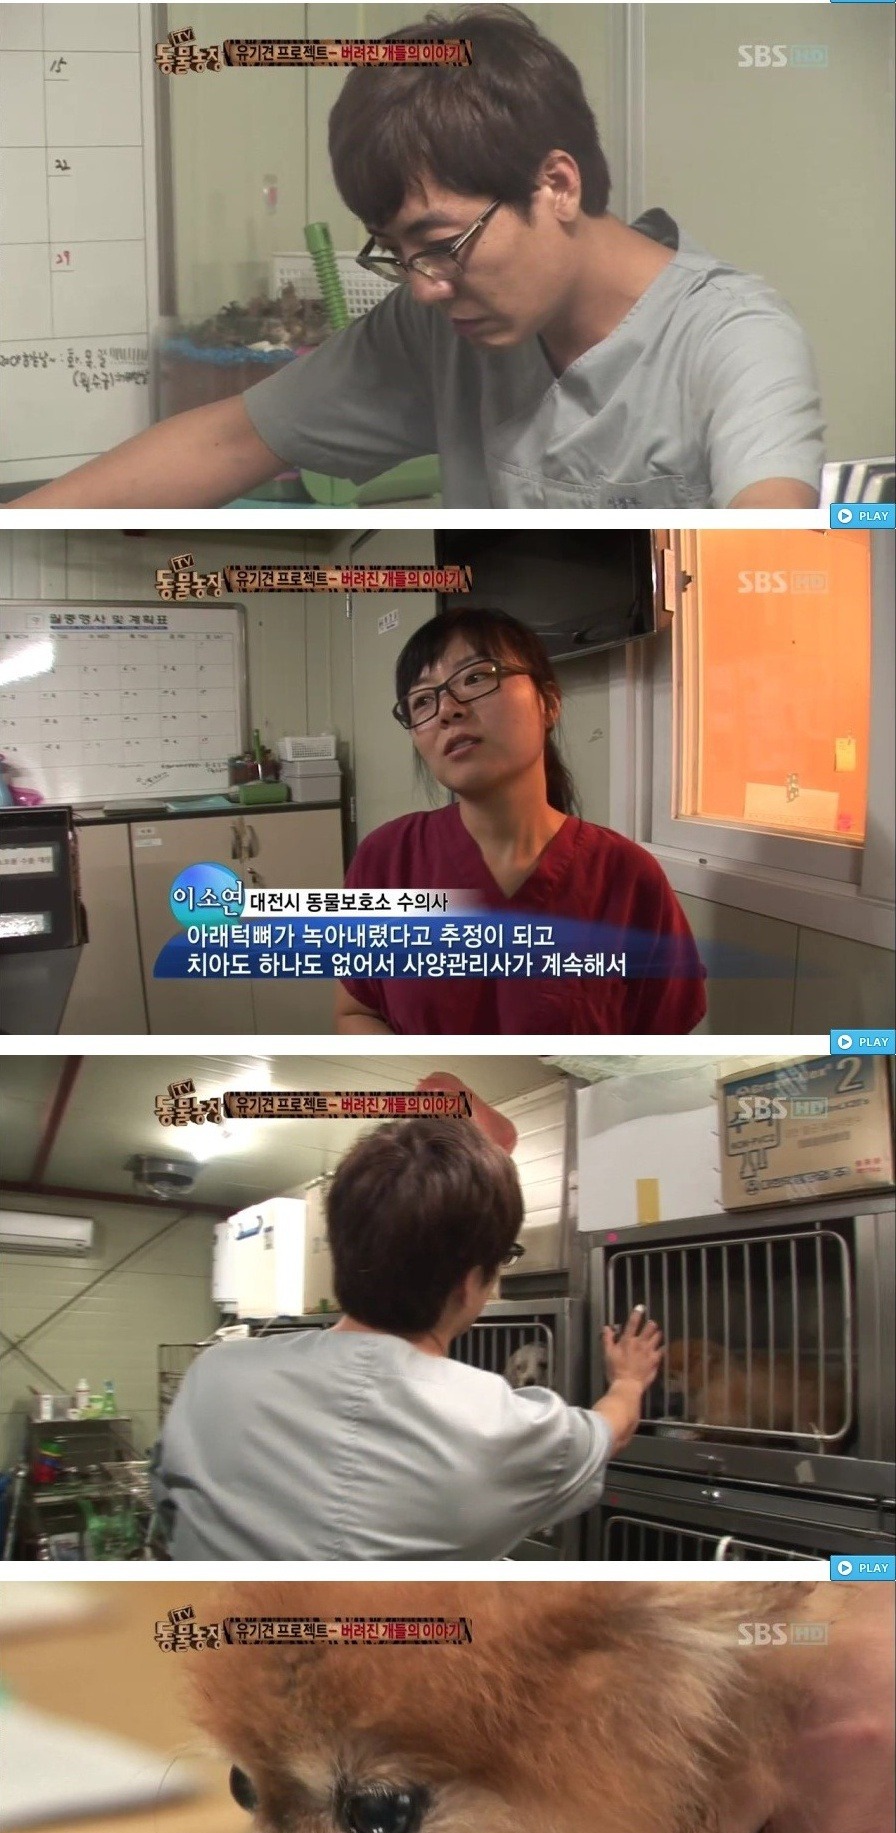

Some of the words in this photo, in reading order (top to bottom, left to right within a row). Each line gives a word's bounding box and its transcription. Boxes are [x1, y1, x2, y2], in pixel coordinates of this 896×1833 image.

[50, 57, 67, 73] 15
[55, 159, 71, 171] 22
[56, 251, 71, 265] 29
[129, 613, 168, 625] 계획표
[836, 1057, 865, 1094] 2
